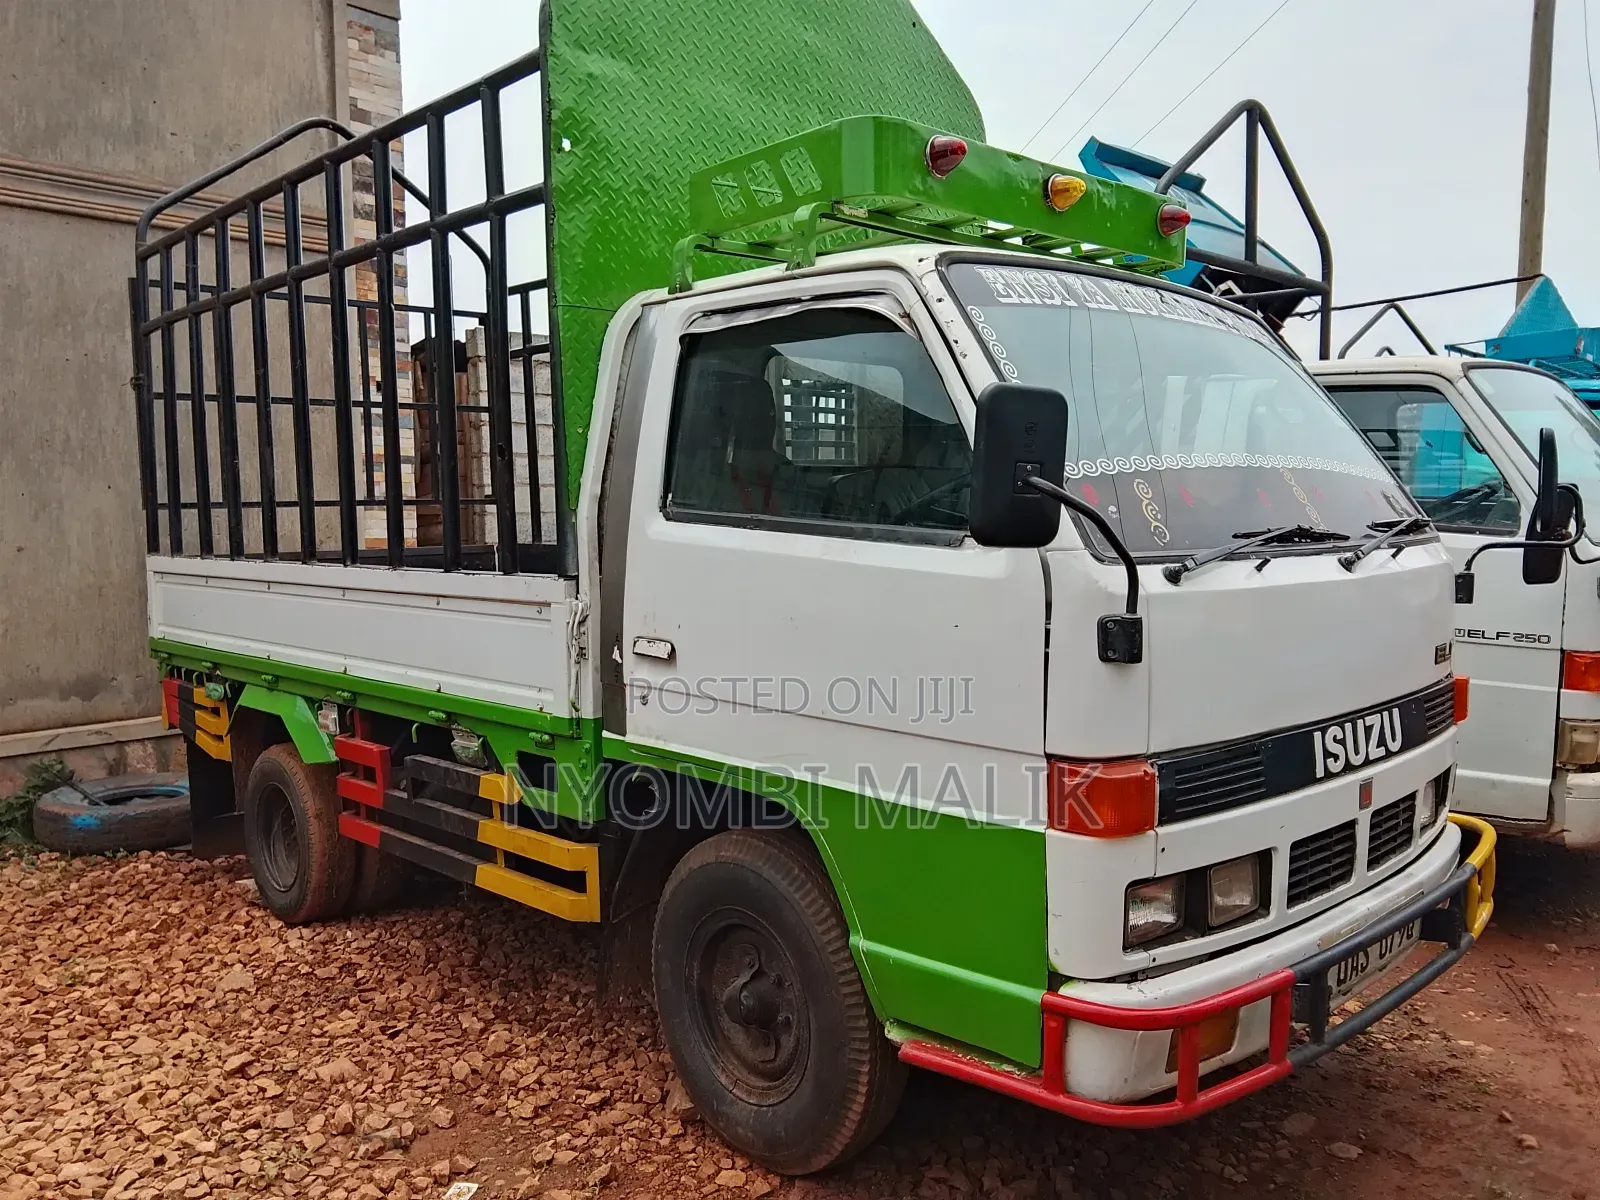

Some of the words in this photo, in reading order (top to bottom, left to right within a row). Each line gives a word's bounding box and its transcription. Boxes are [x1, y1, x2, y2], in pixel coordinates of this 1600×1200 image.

[974, 266, 1078, 307] ENSI
[1055, 271, 1119, 311] YA
[1467, 628, 1511, 641] ELF
[1513, 632, 1552, 644] 250
[1313, 708, 1403, 778] ISUZU
